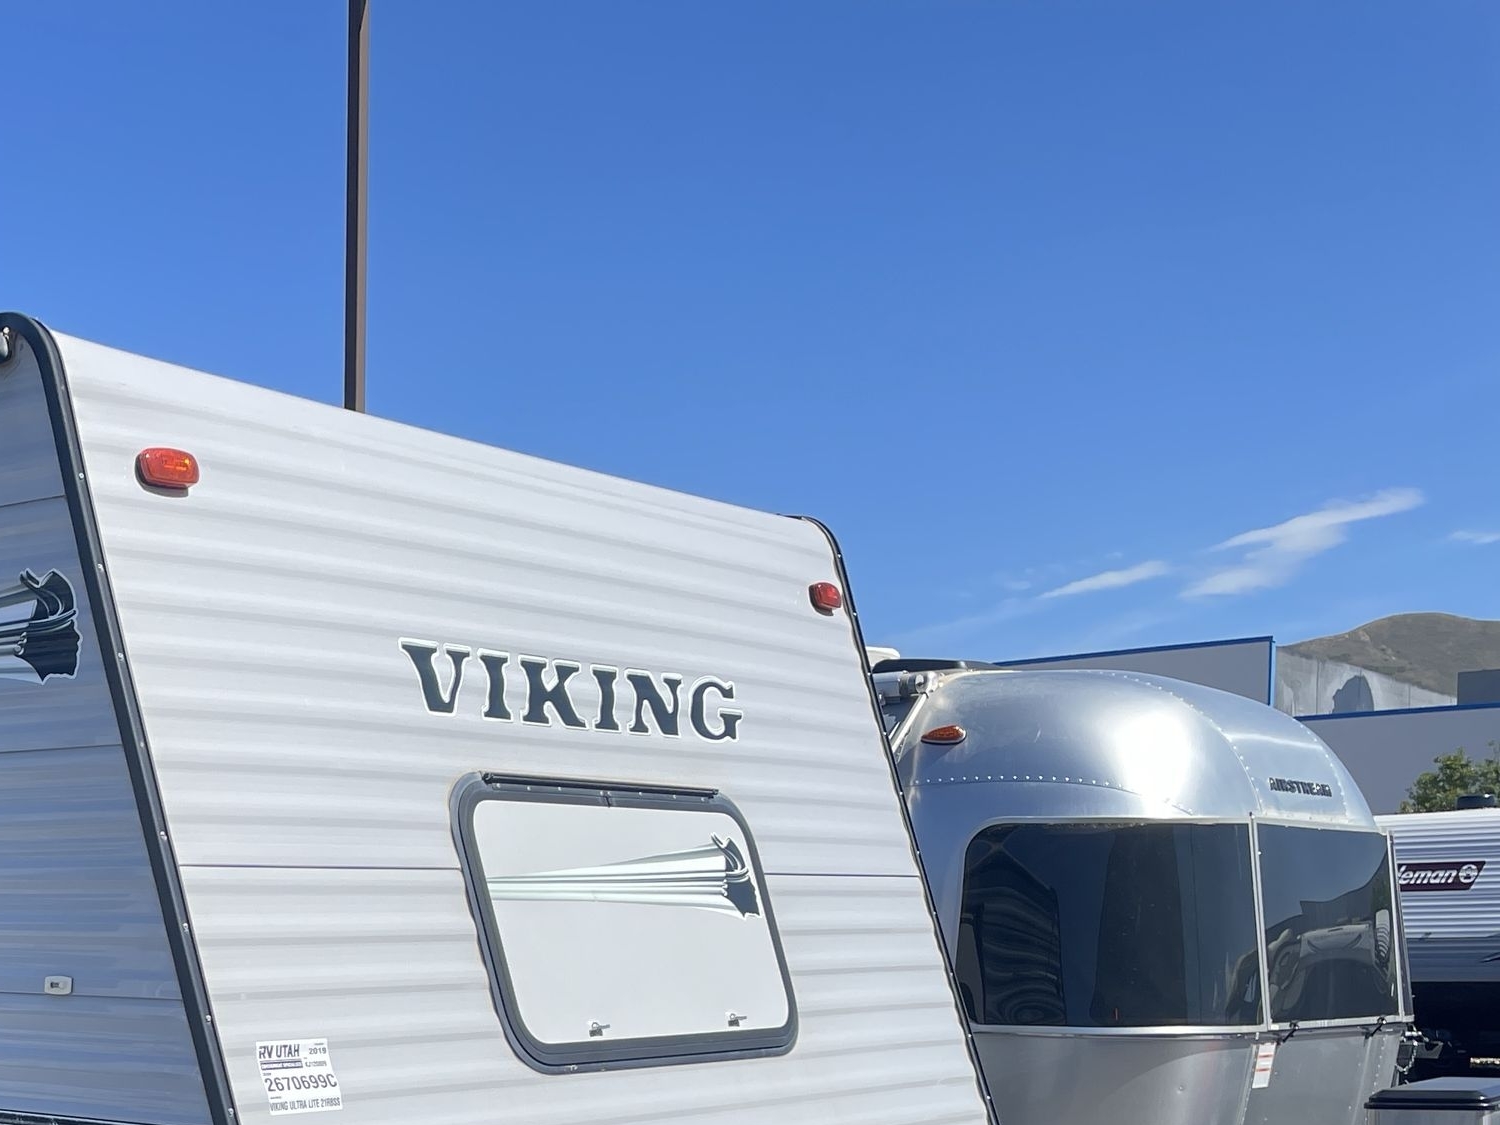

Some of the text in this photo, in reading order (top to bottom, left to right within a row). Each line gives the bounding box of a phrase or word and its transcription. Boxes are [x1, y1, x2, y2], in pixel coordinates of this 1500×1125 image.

[398, 637, 743, 742] VIKING
[258, 1044, 300, 1059] RV UTAH
[308, 1047, 327, 1055] 2019
[264, 1073, 338, 1092] 2670699C
[270, 1101, 289, 1111] VIKING
[289, 1099, 307, 1110] ULTRA
[308, 1098, 320, 1109] LITE
